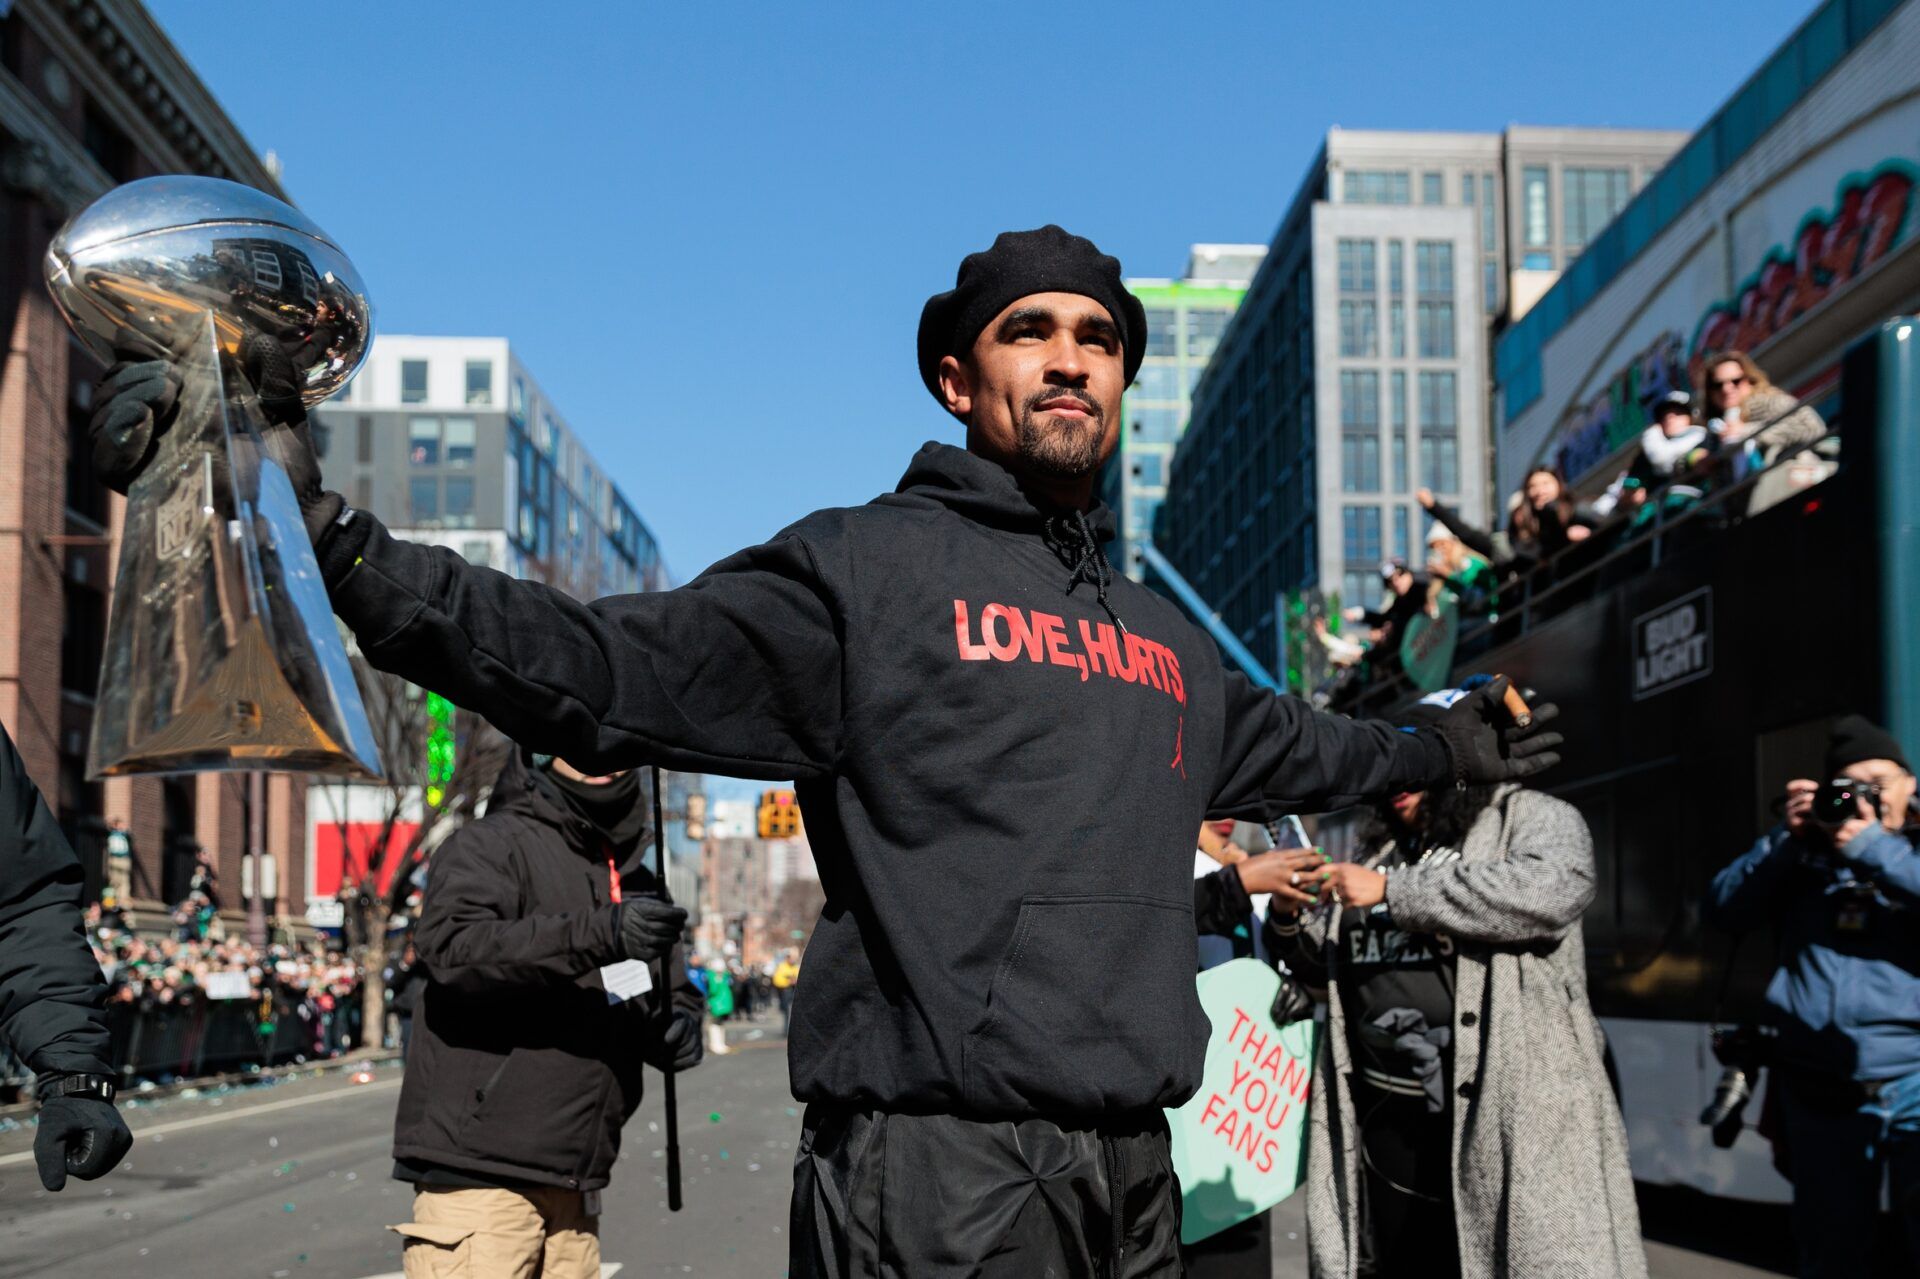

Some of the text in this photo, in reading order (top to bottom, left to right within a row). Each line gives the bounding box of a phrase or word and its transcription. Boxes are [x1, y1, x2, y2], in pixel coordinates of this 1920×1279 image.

[161, 510, 194, 553] NF
[1645, 603, 1697, 653] BUD
[1636, 633, 1706, 689] LIGHT
[1349, 930, 1454, 963] EAGLS
[1229, 1060, 1289, 1130] YOU
[1201, 1093, 1279, 1173] FANS
